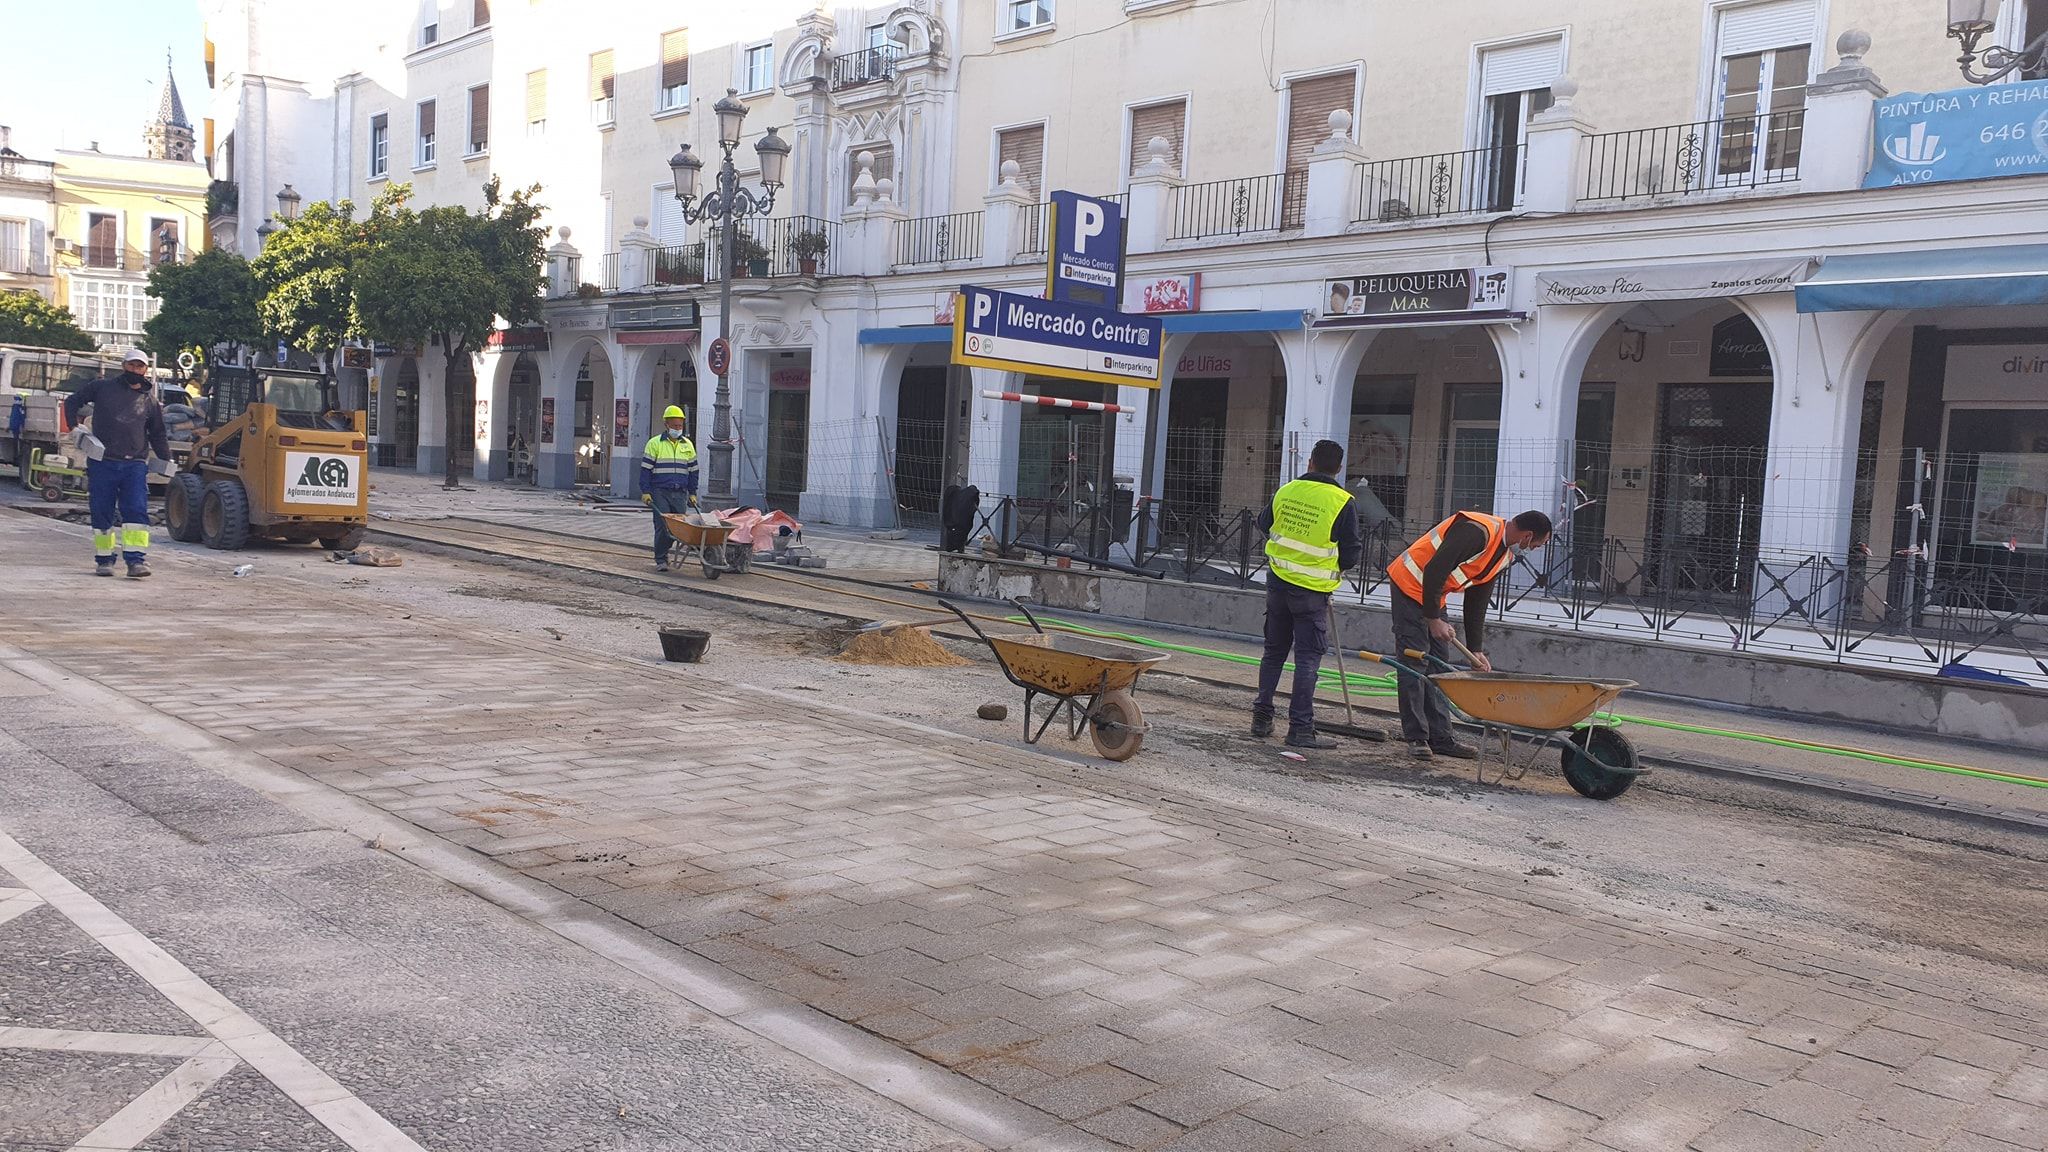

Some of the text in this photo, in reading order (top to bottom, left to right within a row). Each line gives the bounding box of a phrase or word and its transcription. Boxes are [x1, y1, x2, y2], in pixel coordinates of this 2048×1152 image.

[1879, 96, 1961, 119] PINTURA
[1968, 93, 1981, 108] Y
[1979, 122, 2026, 144] 646
[1891, 169, 1934, 186] ALYO
[1074, 199, 1105, 254] P
[1062, 252, 1091, 267] Mercado
[1072, 269, 1112, 286] Interparking
[1358, 272, 1468, 295] PELUQUERIA
[1711, 275, 1792, 289] Zapatos Confort
[1546, 277, 1644, 300] Amparo Pica
[972, 292, 993, 329] P
[1007, 302, 1086, 337] Mercado
[1112, 359, 1153, 375] Interparking
[1178, 355, 1232, 372] de Uñas
[287, 487, 356, 499] Aglomerados Andaluces
